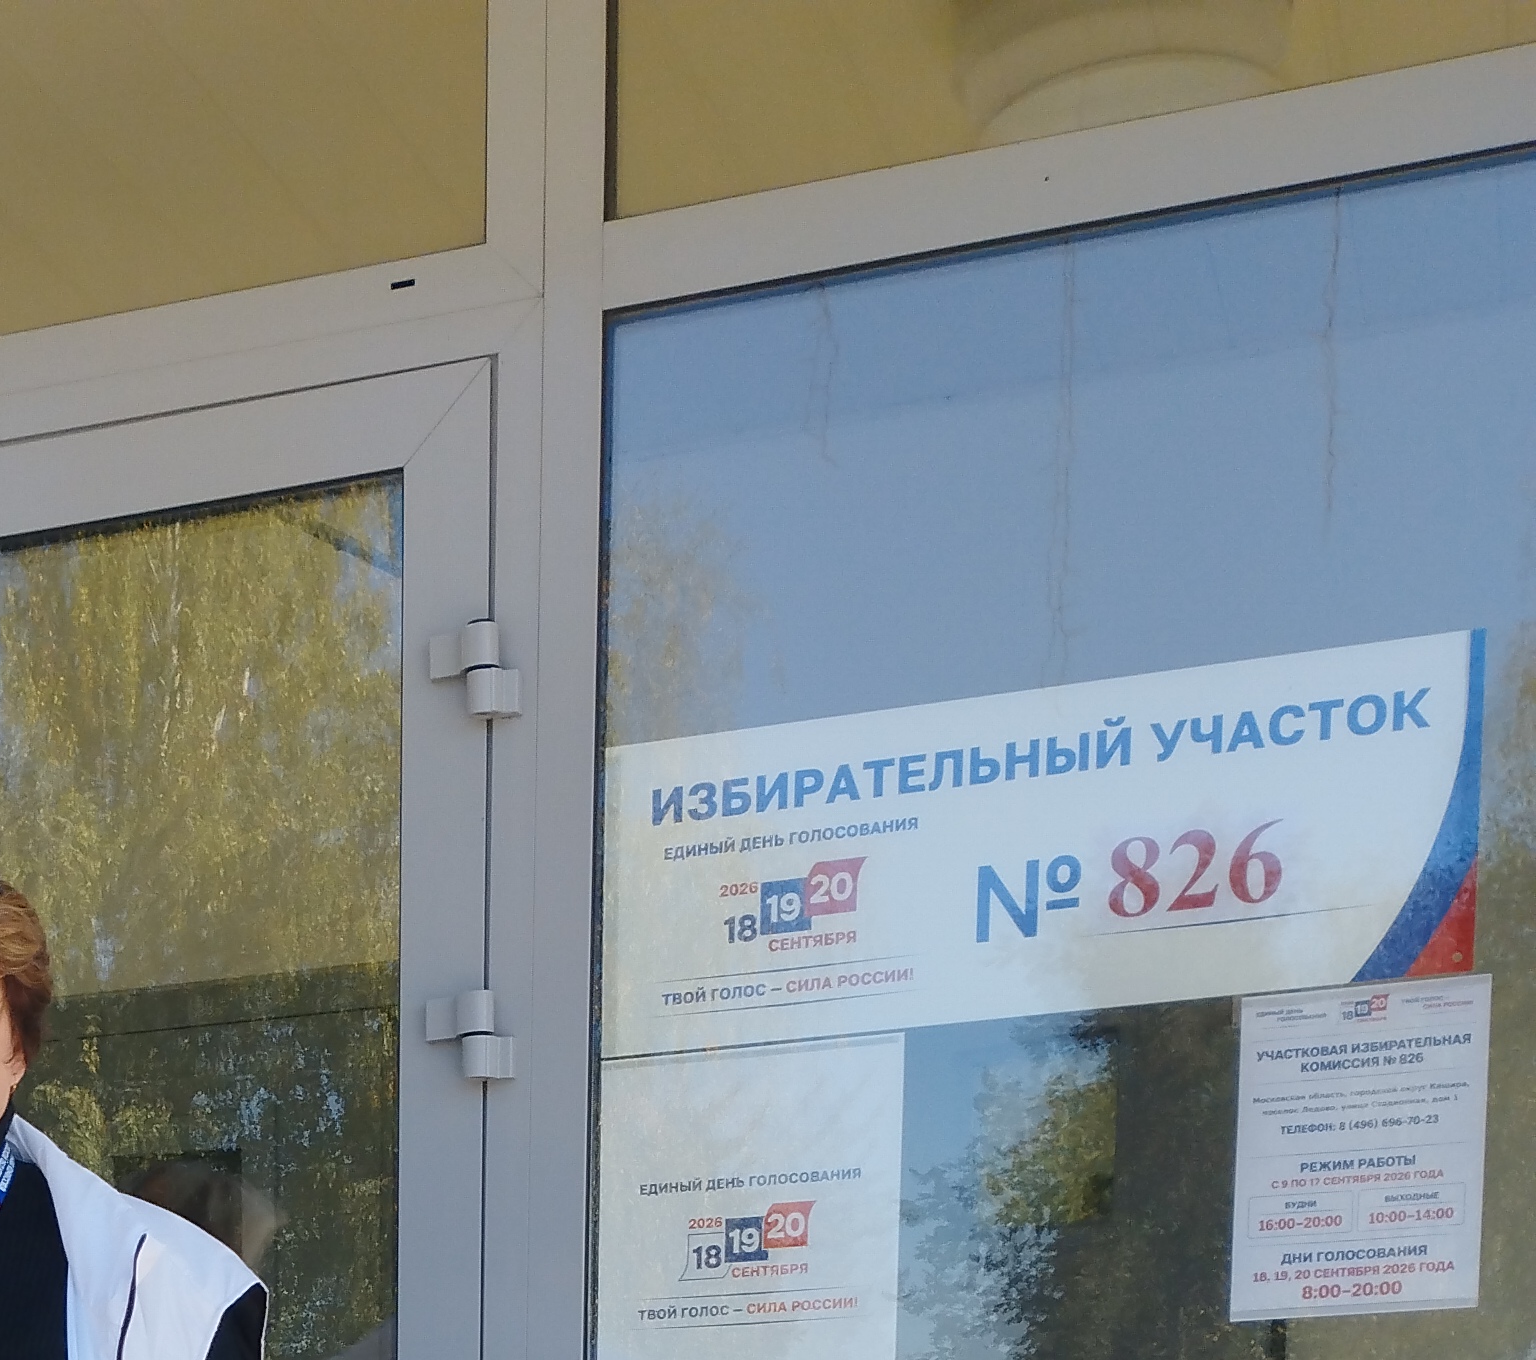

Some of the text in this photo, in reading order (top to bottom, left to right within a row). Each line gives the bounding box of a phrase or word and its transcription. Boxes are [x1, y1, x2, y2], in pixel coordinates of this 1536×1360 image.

[650, 686, 1432, 827] ИЗБИРАТЕЛЬНЫЙ УЧАСТОК
[663, 816, 920, 862] ЕДИНЫЙ ДЕНЬ ГОЛОСОВАНИЯ
[718, 881, 759, 898] 2026
[975, 818, 1286, 944] № 826
[723, 871, 854, 944] 18 19 20
[767, 930, 857, 953] СЕНТЯБРЯ
[661, 984, 707, 1006] ТВОЙ
[710, 984, 767, 1002] ГОЛОС
[785, 974, 832, 993] СИЛА
[837, 967, 914, 989] РОССИИ!
[1341, 1010, 1354, 1021] 18
[1370, 997, 1387, 1010] 20
[1256, 1032, 1472, 1063] УЧАСТКОВАЯ ИЗБИРАТЕЛЬНАЯ
[1300, 1057, 1380, 1073] КОМИССИЯ
[1400, 1053, 1424, 1065] 826
[1280, 1123, 1337, 1136] ТЕЛЕФОН:
[1338, 1121, 1346, 1131] 8
[1348, 1118, 1378, 1131] (496)
[1300, 1154, 1416, 1174] РЕЖИМ РАБОТЫ
[639, 1167, 863, 1197] ЕДИНЫЙ ДЕНЬ ГОЛОСОВАНИЯ
[1271, 1179, 1280, 1190] С
[1281, 1179, 1288, 1189] 9
[1290, 1178, 1307, 1188] ПО
[1322, 1172, 1381, 1187] СЕНТЯБРЯ
[1383, 1171, 1411, 1183] 2026
[1413, 1168, 1444, 1180] ГОДА
[687, 1216, 724, 1230] 2026
[692, 1212, 806, 1271] 18 19 20
[1280, 1244, 1428, 1266] ДНИ ГОЛОСОВАНИЯ
[731, 1262, 809, 1279] СЕНТЯБРЯ
[1294, 1269, 1311, 1281] 20
[1313, 1264, 1380, 1279] СЕНТЯБРЯ
[1382, 1262, 1416, 1275] 2026
[1419, 1259, 1455, 1273] ГОДА
[638, 1303, 678, 1322] ТВОЙ
[680, 1303, 729, 1319] ГОЛОС
[746, 1299, 788, 1316] СИЛА
[791, 1296, 859, 1313] РОССИИ!
